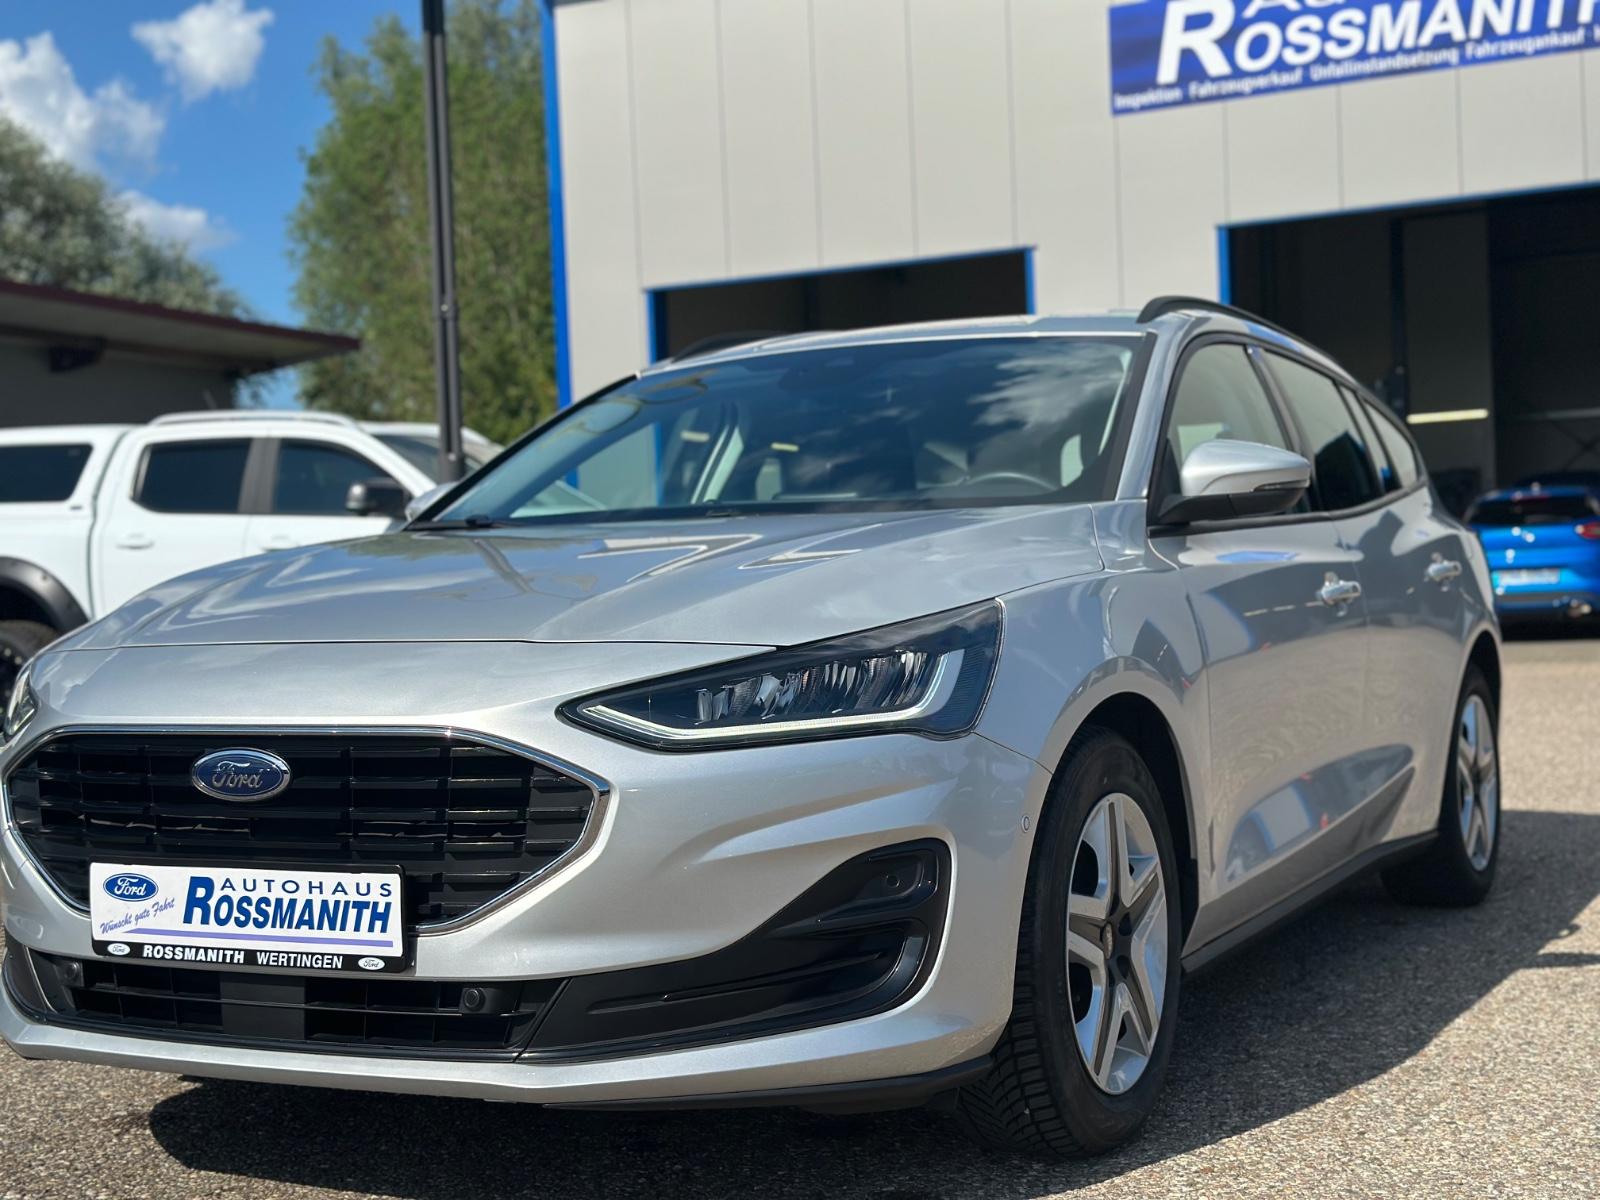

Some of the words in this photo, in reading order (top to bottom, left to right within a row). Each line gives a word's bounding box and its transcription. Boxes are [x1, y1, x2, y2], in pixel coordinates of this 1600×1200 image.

[212, 760, 271, 788] Ford
[114, 877, 147, 896] Ford
[220, 877, 393, 897] AUTOHAUS
[134, 908, 151, 925] gute
[151, 897, 175, 917] Fahrt
[183, 876, 393, 934] ROSSMANITH
[142, 944, 245, 964] ROSSMANITH
[256, 951, 344, 969] WERTINGEN
